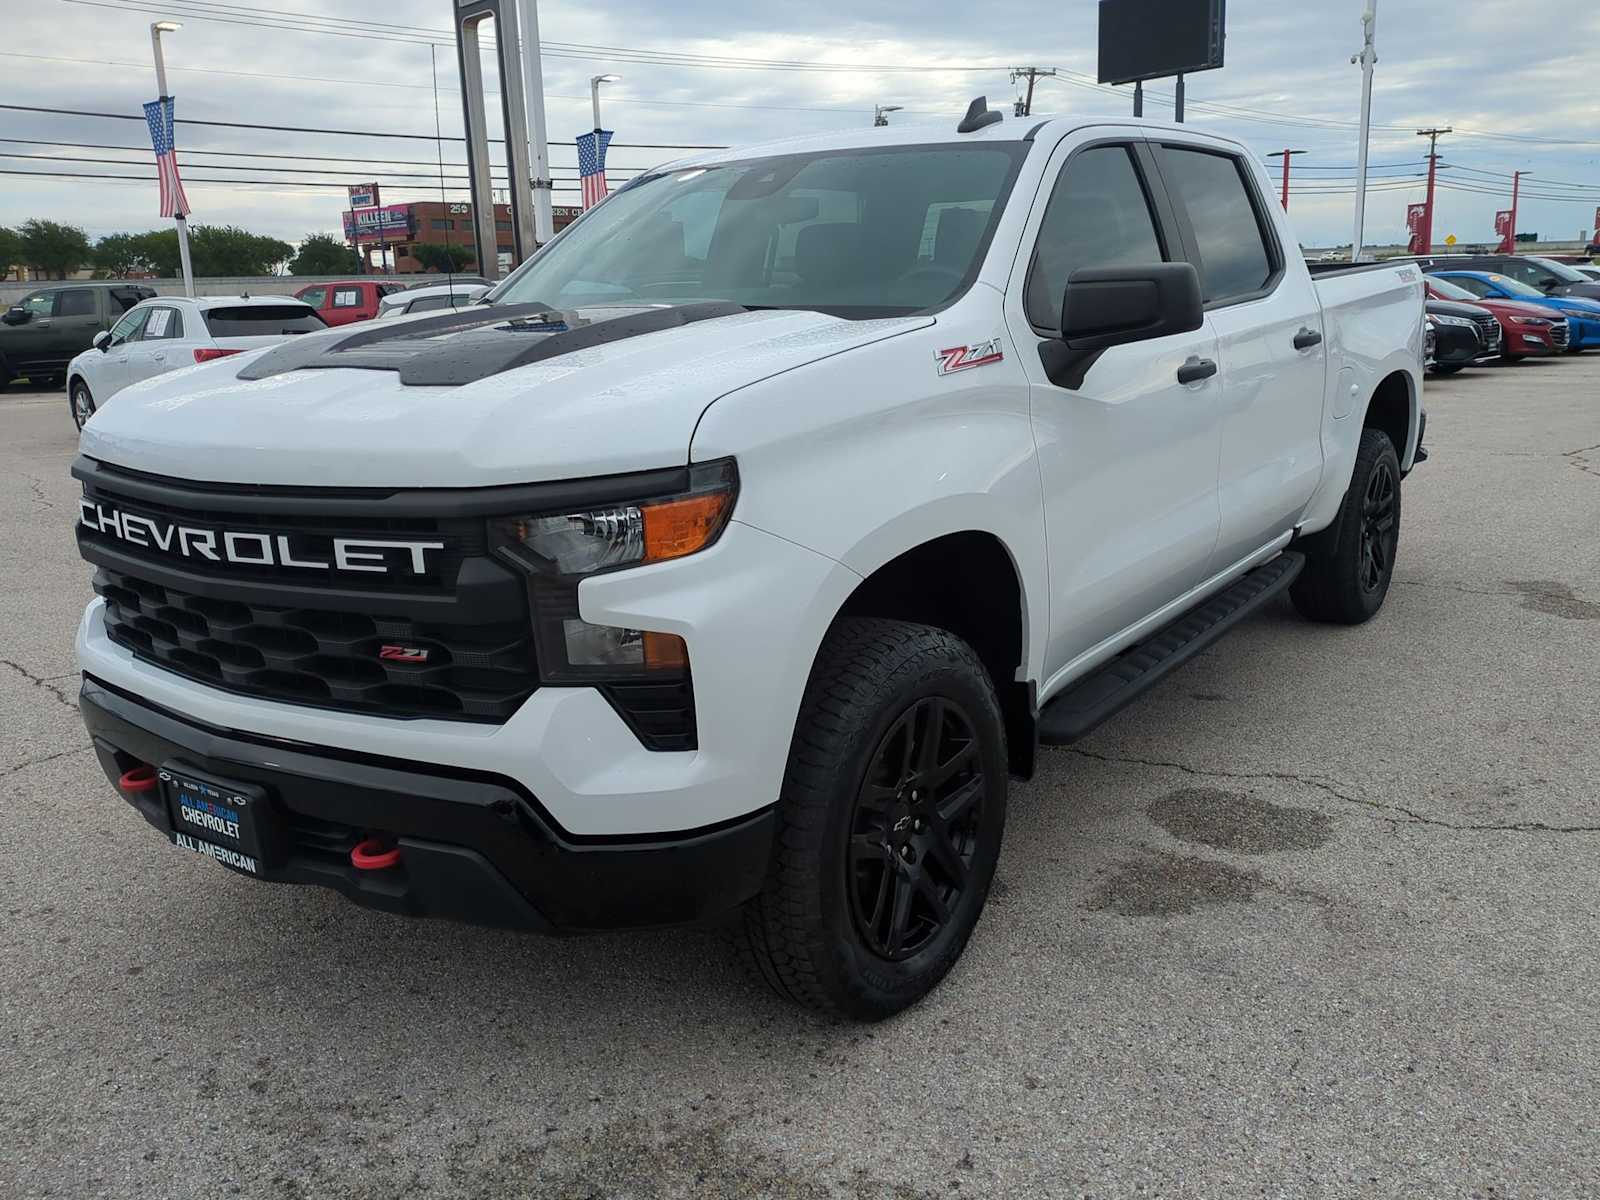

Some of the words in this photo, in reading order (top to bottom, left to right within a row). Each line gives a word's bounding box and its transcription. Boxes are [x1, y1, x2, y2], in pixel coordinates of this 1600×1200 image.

[935, 337, 1004, 376] Z71
[79, 499, 445, 575] CHEVROLET
[379, 645, 429, 663] Z71
[181, 804, 240, 839] CHEVROLET
[176, 833, 197, 852] ALL
[198, 841, 256, 873] AMERICAN
